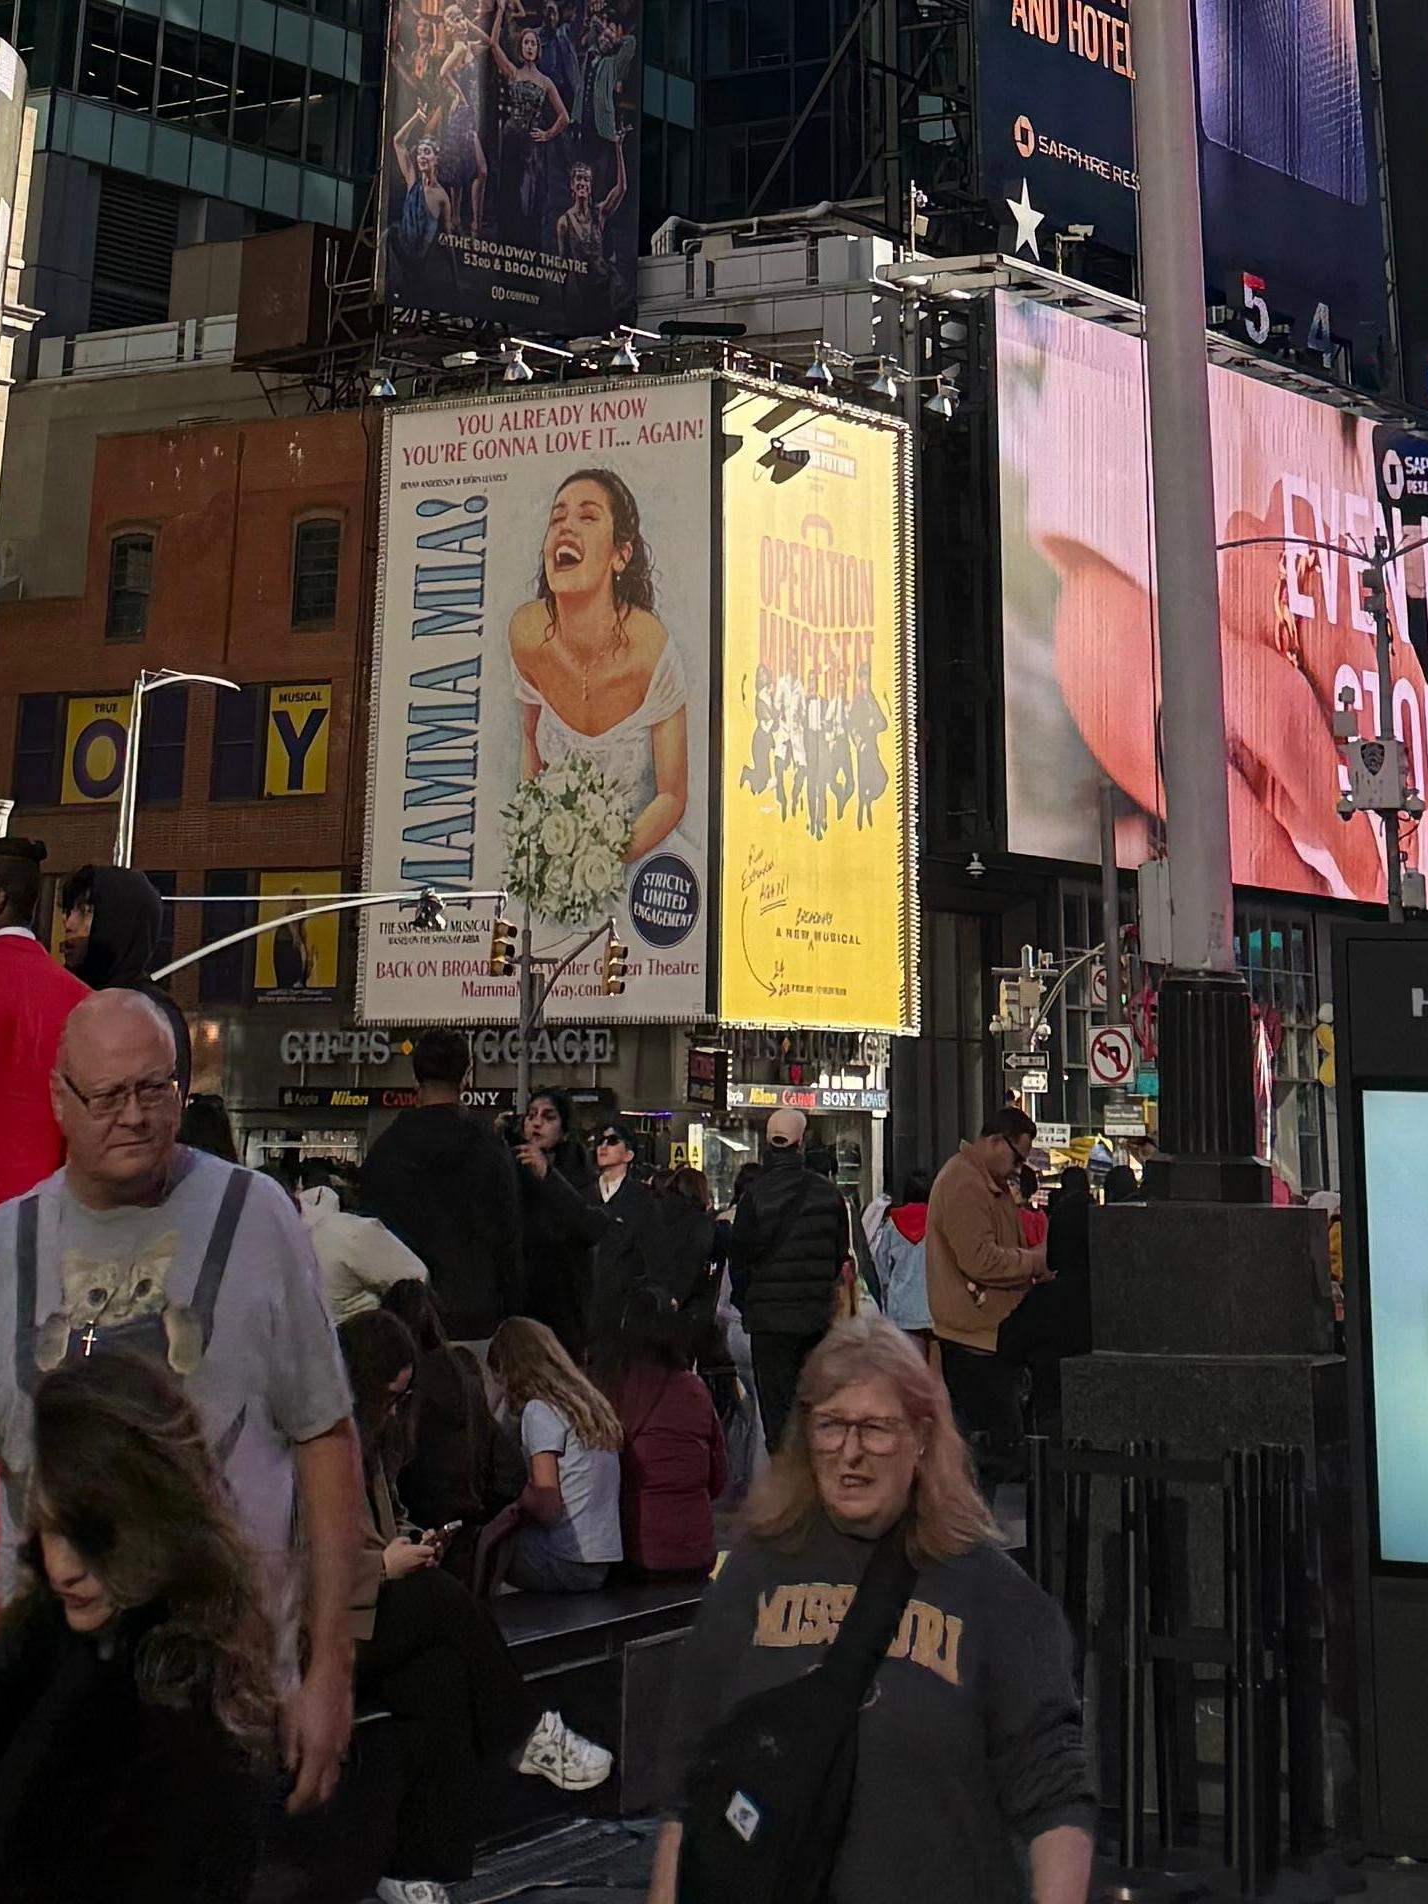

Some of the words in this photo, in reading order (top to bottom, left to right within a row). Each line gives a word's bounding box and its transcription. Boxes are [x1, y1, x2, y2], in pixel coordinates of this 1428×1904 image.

[1038, 136, 1110, 181] SAPPHIRE
[473, 238, 537, 262] BROADWAY
[539, 253, 589, 274] THEATRE
[493, 258, 502, 272] &
[504, 260, 567, 285] BROADWAY
[458, 413, 494, 436] YOU
[500, 403, 584, 433] ALREADY
[590, 396, 648, 423] KNOW
[402, 443, 467, 467] YOU'RE
[473, 437, 538, 461] GONNA
[546, 430, 592, 454] LOVE
[599, 427, 631, 449] IT...
[637, 418, 704, 446] AGAIN!
[411, 494, 490, 641] MIA!
[1281, 472, 1412, 645] EVEN
[759, 535, 874, 629] OPERATION
[94, 701, 119, 714] TRUE
[278, 690, 324, 704] MUSICAL
[73, 718, 128, 799] O
[271, 707, 329, 792] Y
[397, 659, 483, 913] MAMMA
[641, 871, 692, 895] STRICTLY
[642, 889, 688, 911] LIMITED
[450, 919, 492, 933] MUSICAL
[633, 905, 694, 929] ENGAGEMENT
[775, 926, 782, 938] A
[785, 928, 810, 941] NEW
[813, 930, 862, 946] MUSICAL
[376, 961, 414, 979] BACK
[416, 961, 439, 978] ON
[441, 959, 502, 977] BROAD
[645, 958, 700, 976] Theatre
[280, 1030, 392, 1065] GIFTS
[330, 1090, 369, 1106] Nikon
[460, 1091, 500, 1106] ONY
[748, 1087, 778, 1105] Nikon
[781, 1088, 818, 1107] Canon
[822, 1091, 857, 1107] SONY
